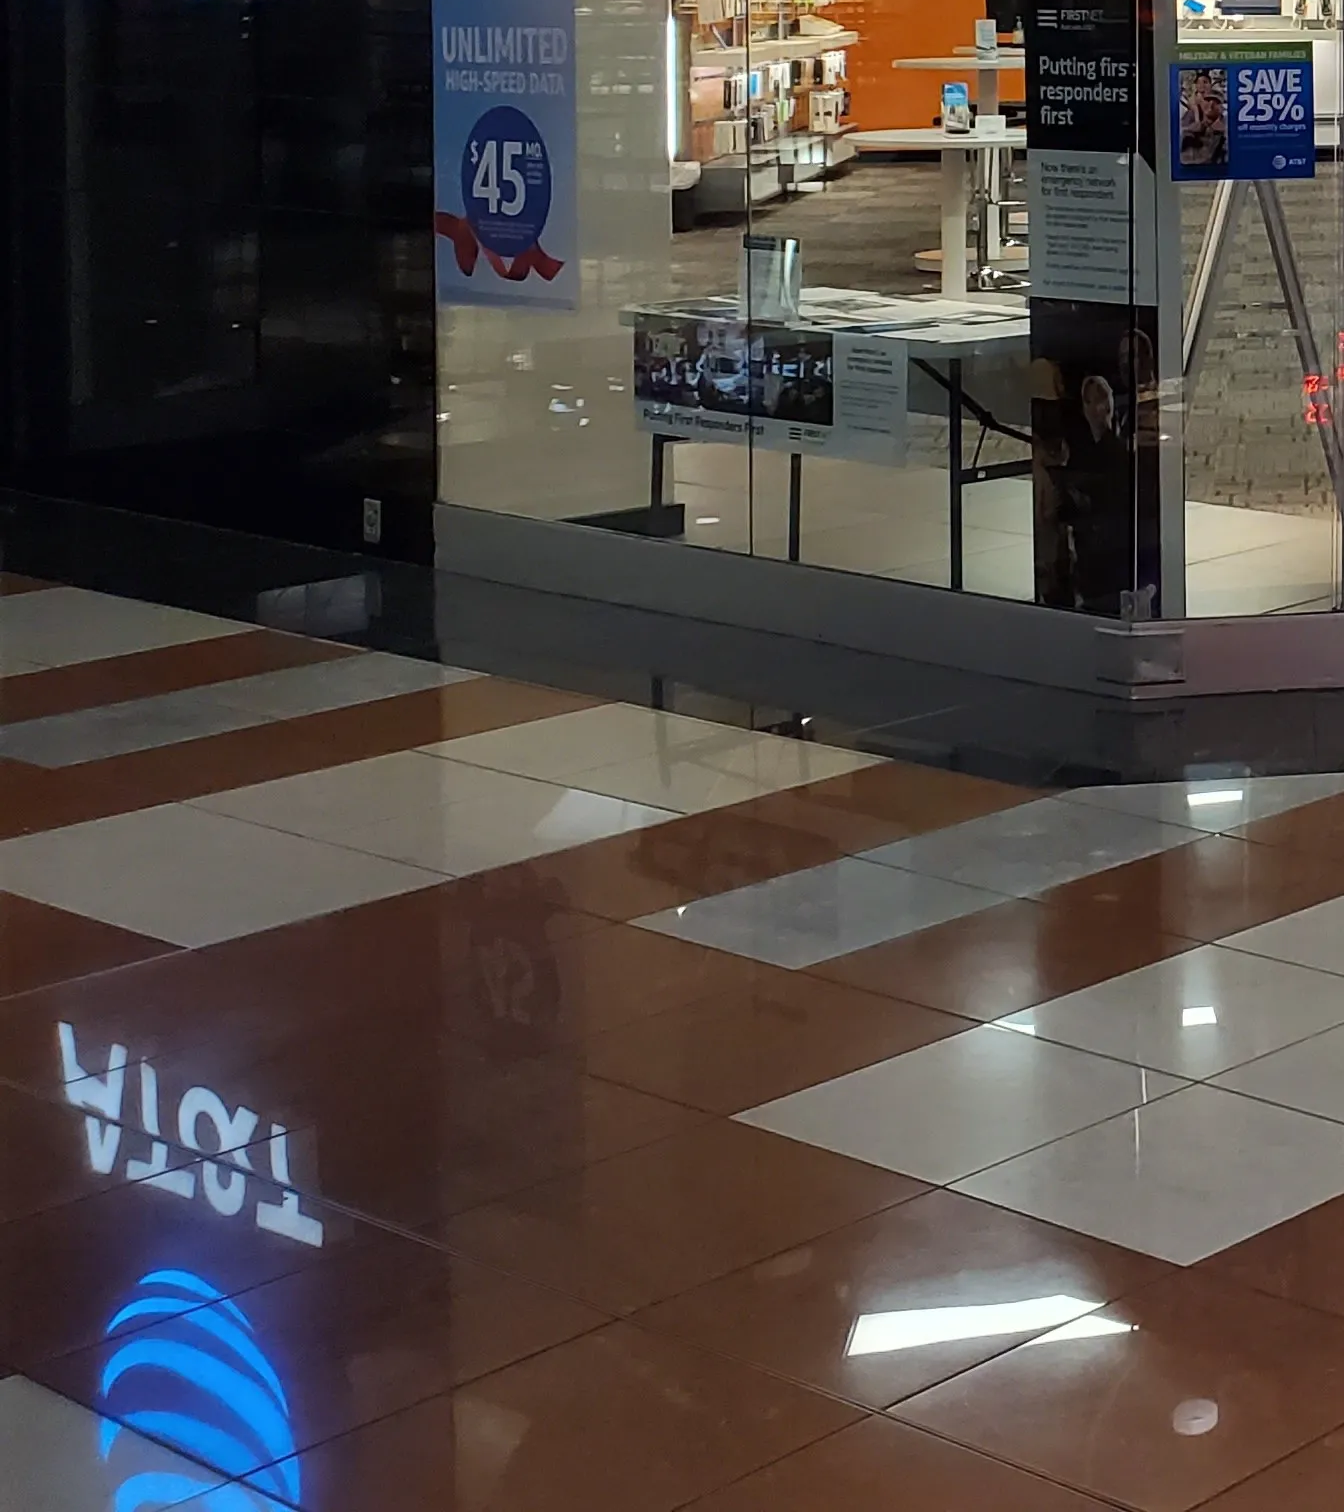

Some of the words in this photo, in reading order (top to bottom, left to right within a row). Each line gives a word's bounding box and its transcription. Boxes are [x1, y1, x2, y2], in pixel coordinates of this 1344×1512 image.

[442, 26, 568, 65] UNLIMITED
[1179, 51, 1217, 61] MILITARY
[1229, 50, 1267, 60] VETERAN
[1269, 50, 1306, 59] FAMILIES
[1040, 56, 1096, 80] Putting
[445, 69, 526, 94] HIGH-SPEED
[529, 73, 567, 96] DATA
[1237, 68, 1302, 93] SAVE
[1040, 82, 1128, 105] responders
[1040, 105, 1074, 125] first
[1237, 93, 1305, 122] 25%
